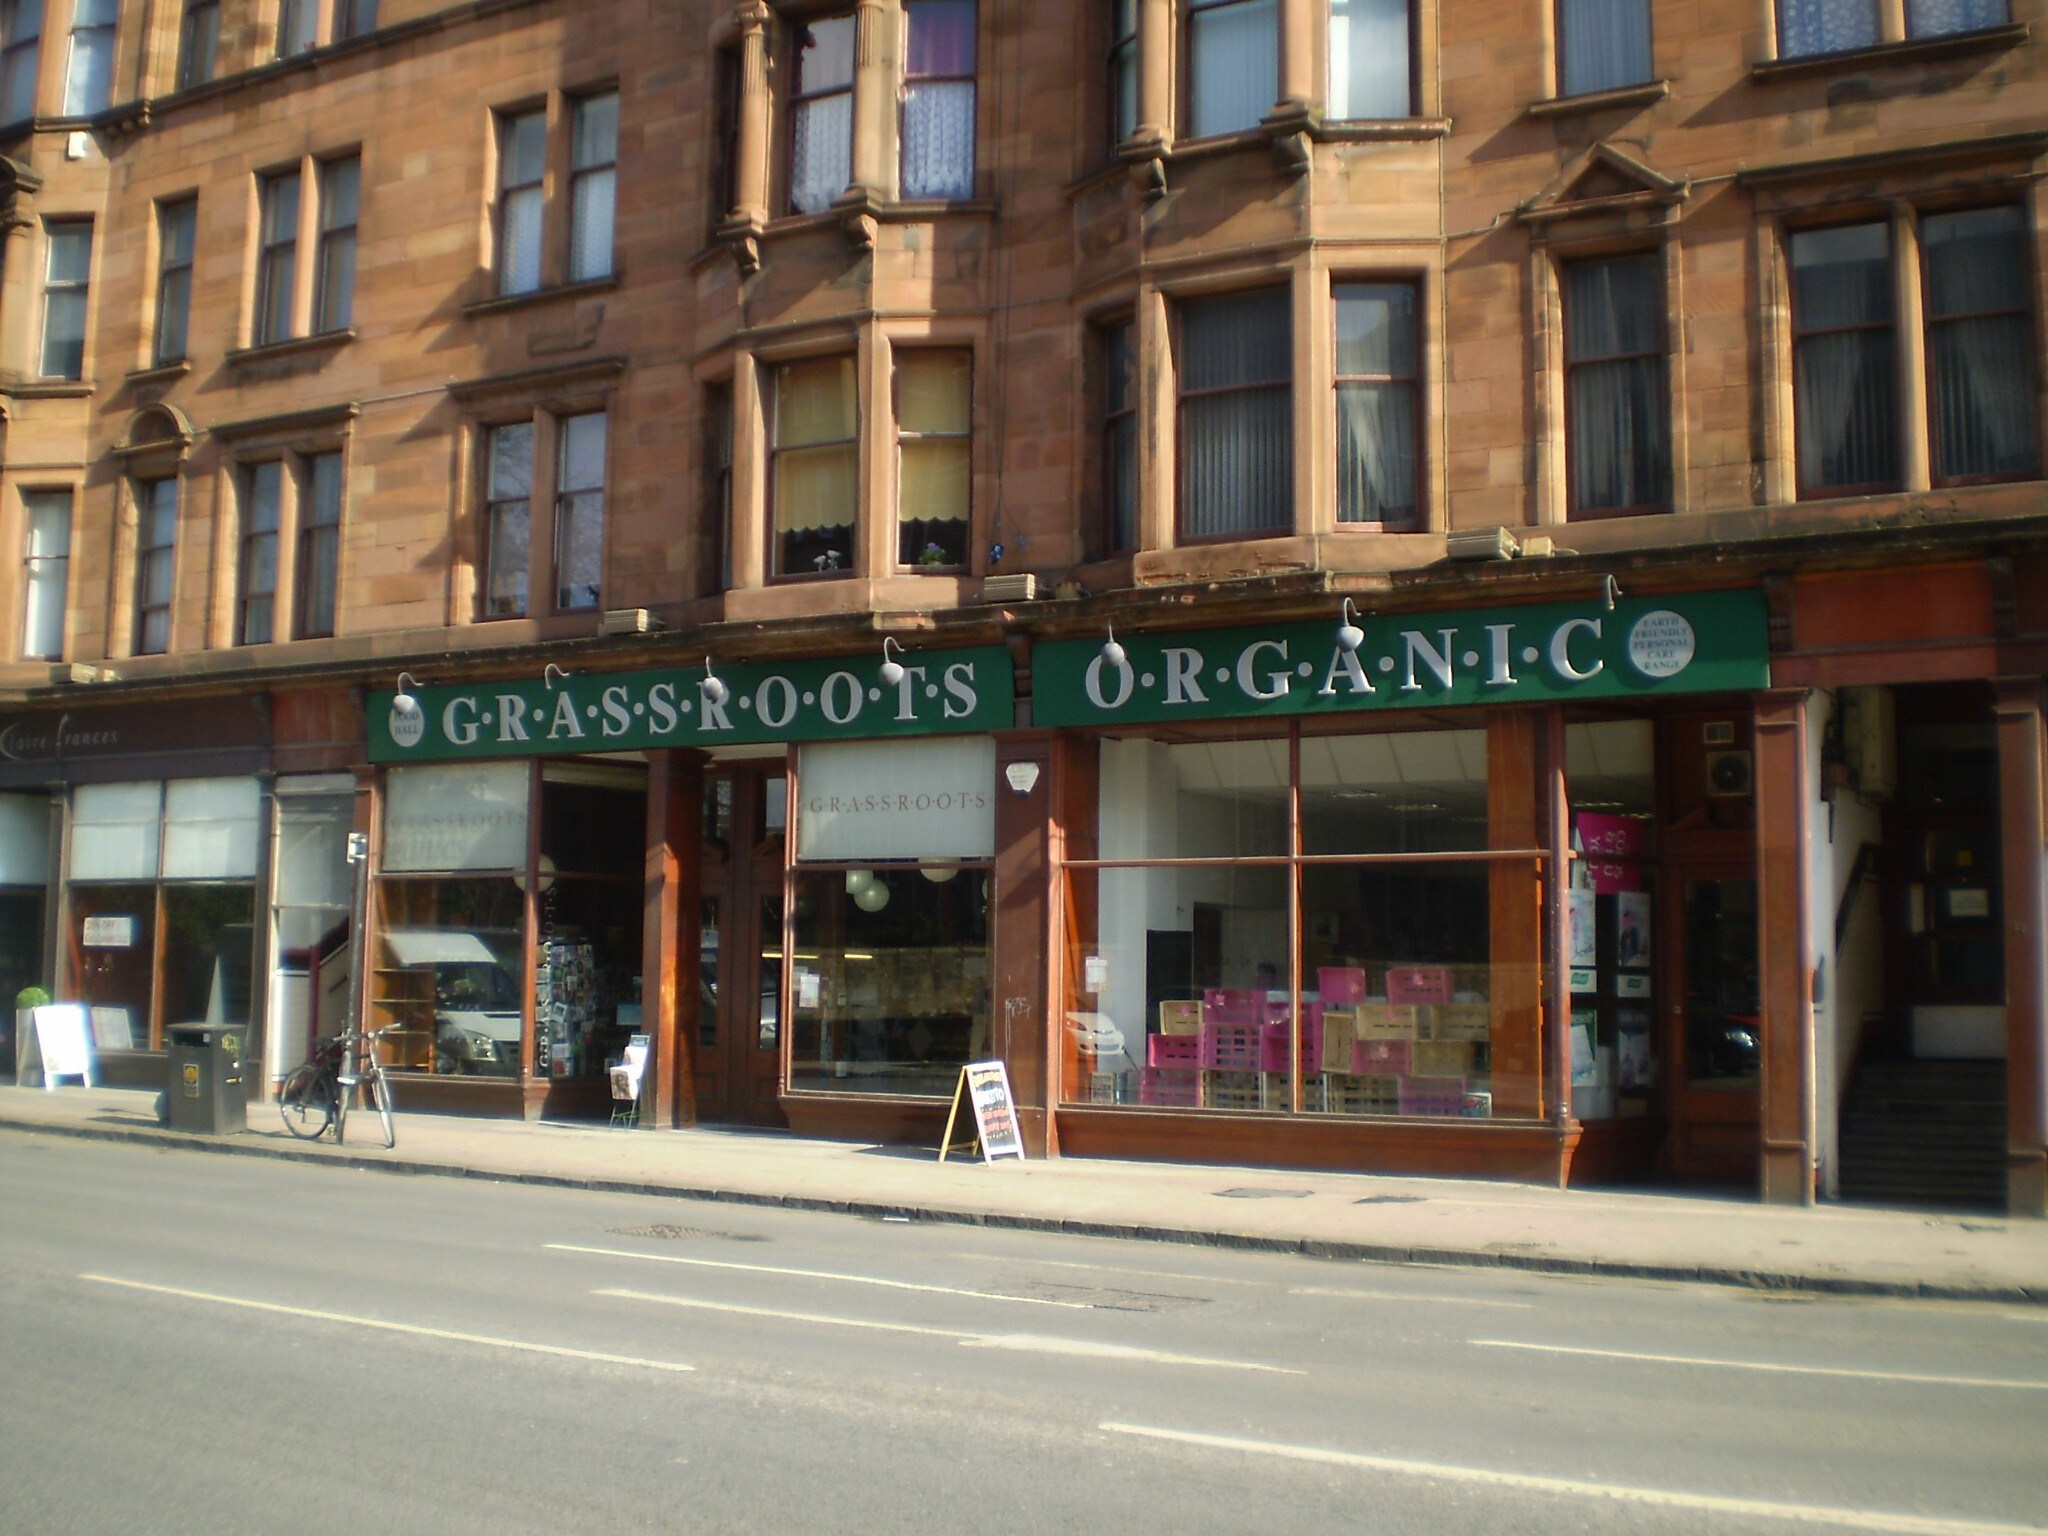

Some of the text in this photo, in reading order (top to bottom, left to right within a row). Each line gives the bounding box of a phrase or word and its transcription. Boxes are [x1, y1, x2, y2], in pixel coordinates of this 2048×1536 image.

[1644, 617, 1680, 627] EARTH
[1634, 627, 1686, 638] FRIENDLY
[1634, 638, 1687, 649] PERSONAL
[1647, 650, 1673, 658] CARE
[1644, 660, 1679, 669] RANGE
[394, 725, 419, 736] HALL
